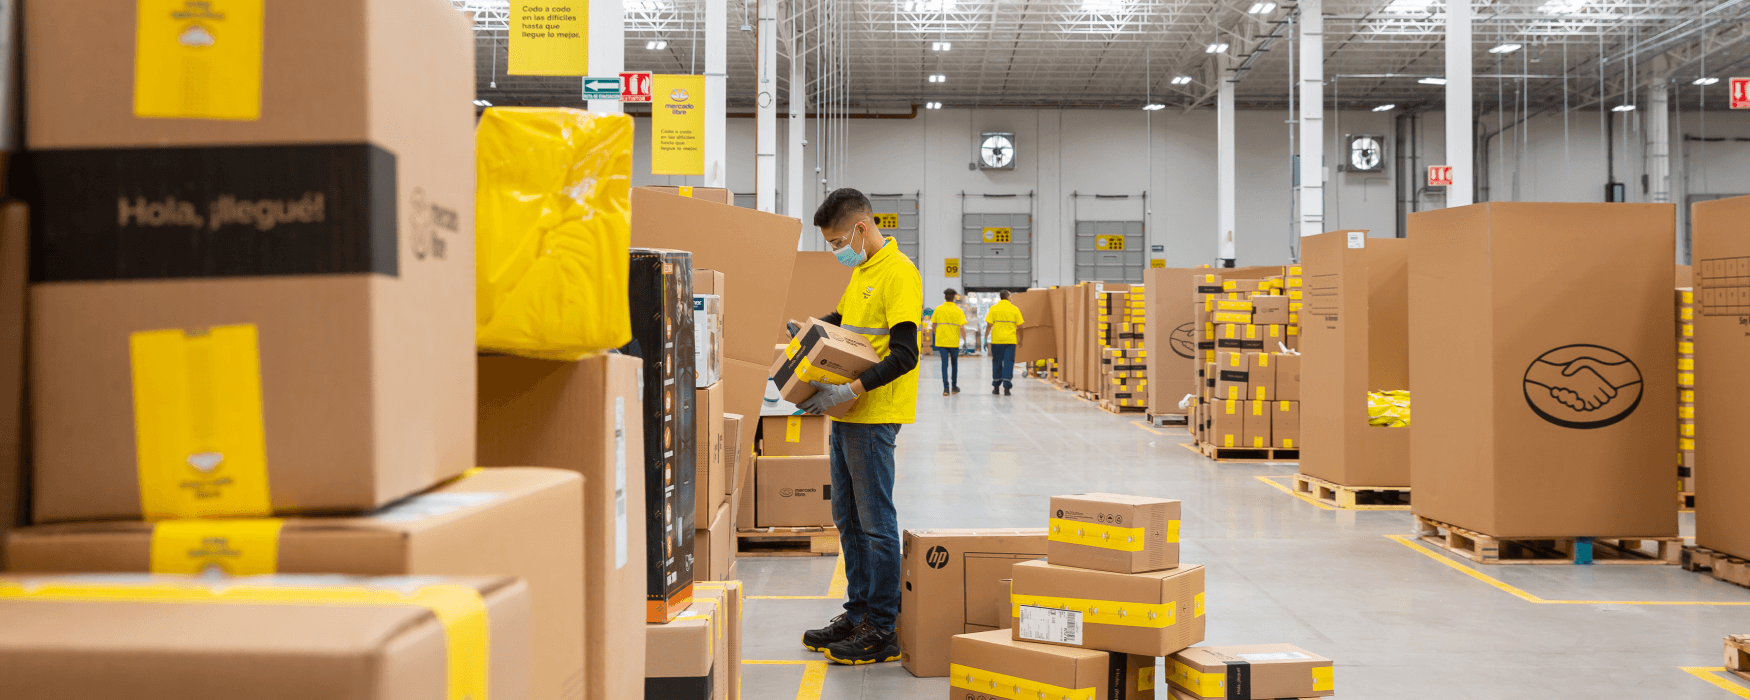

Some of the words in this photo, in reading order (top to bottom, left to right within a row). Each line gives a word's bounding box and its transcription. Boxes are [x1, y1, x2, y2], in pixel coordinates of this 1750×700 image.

[522, 5, 543, 13] Codo
[551, 5, 572, 13] codo
[534, 13, 545, 21] las
[522, 22, 543, 30] hasta
[522, 31, 546, 39] llegue
[557, 31, 580, 39] mejor.
[117, 196, 204, 230] Hola,
[926, 545, 949, 569] hp
